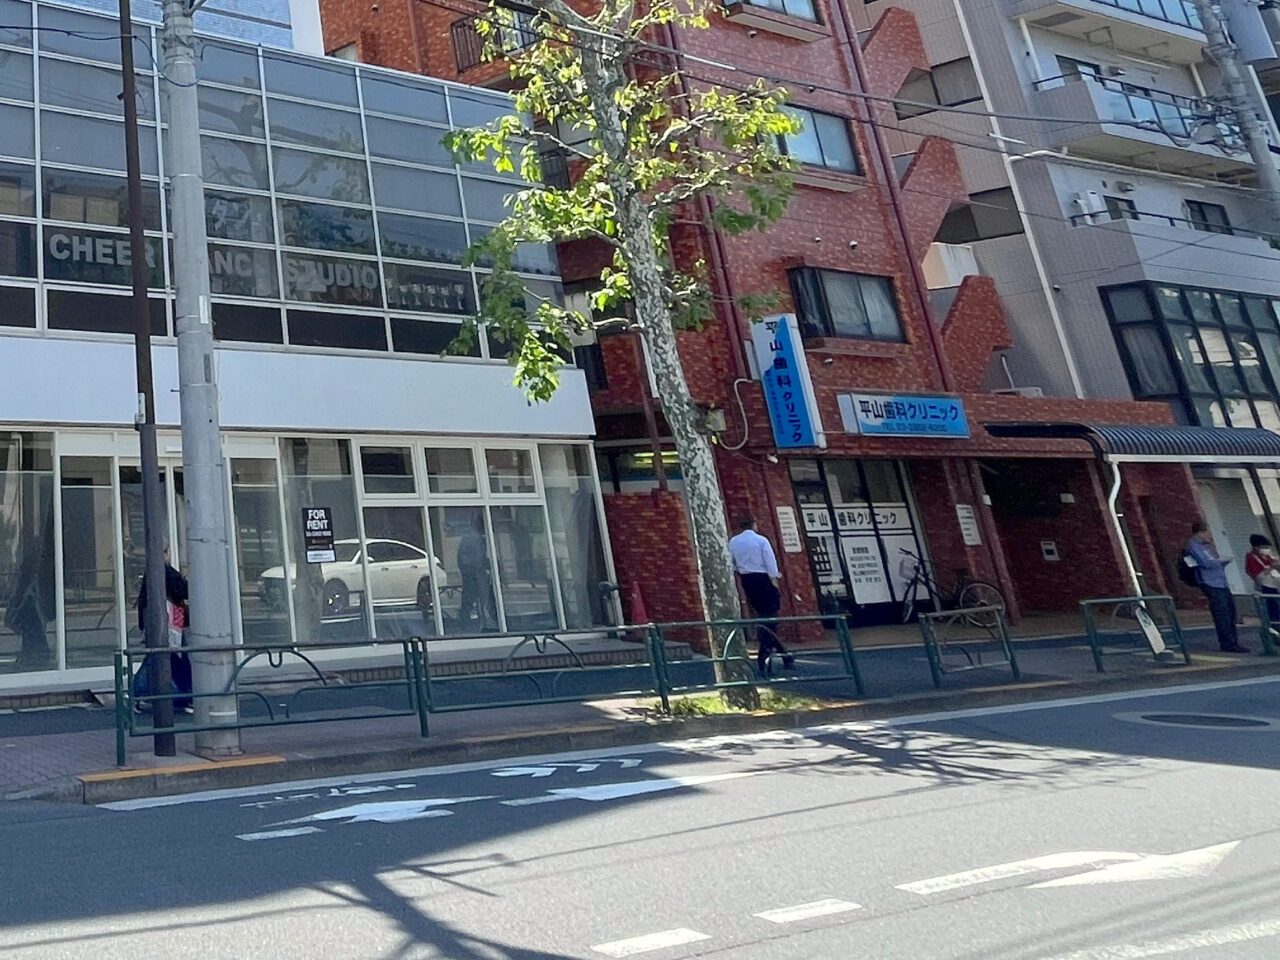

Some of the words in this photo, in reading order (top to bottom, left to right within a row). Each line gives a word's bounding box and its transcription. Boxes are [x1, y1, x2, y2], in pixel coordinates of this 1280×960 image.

[286, 257, 378, 290] STUDIO
[765, 320, 802, 443] 平山歯科クリニック
[858, 399, 959, 421] 平山歯科クリニック
[306, 519, 328, 530] RENT
[308, 509, 326, 520] FOR
